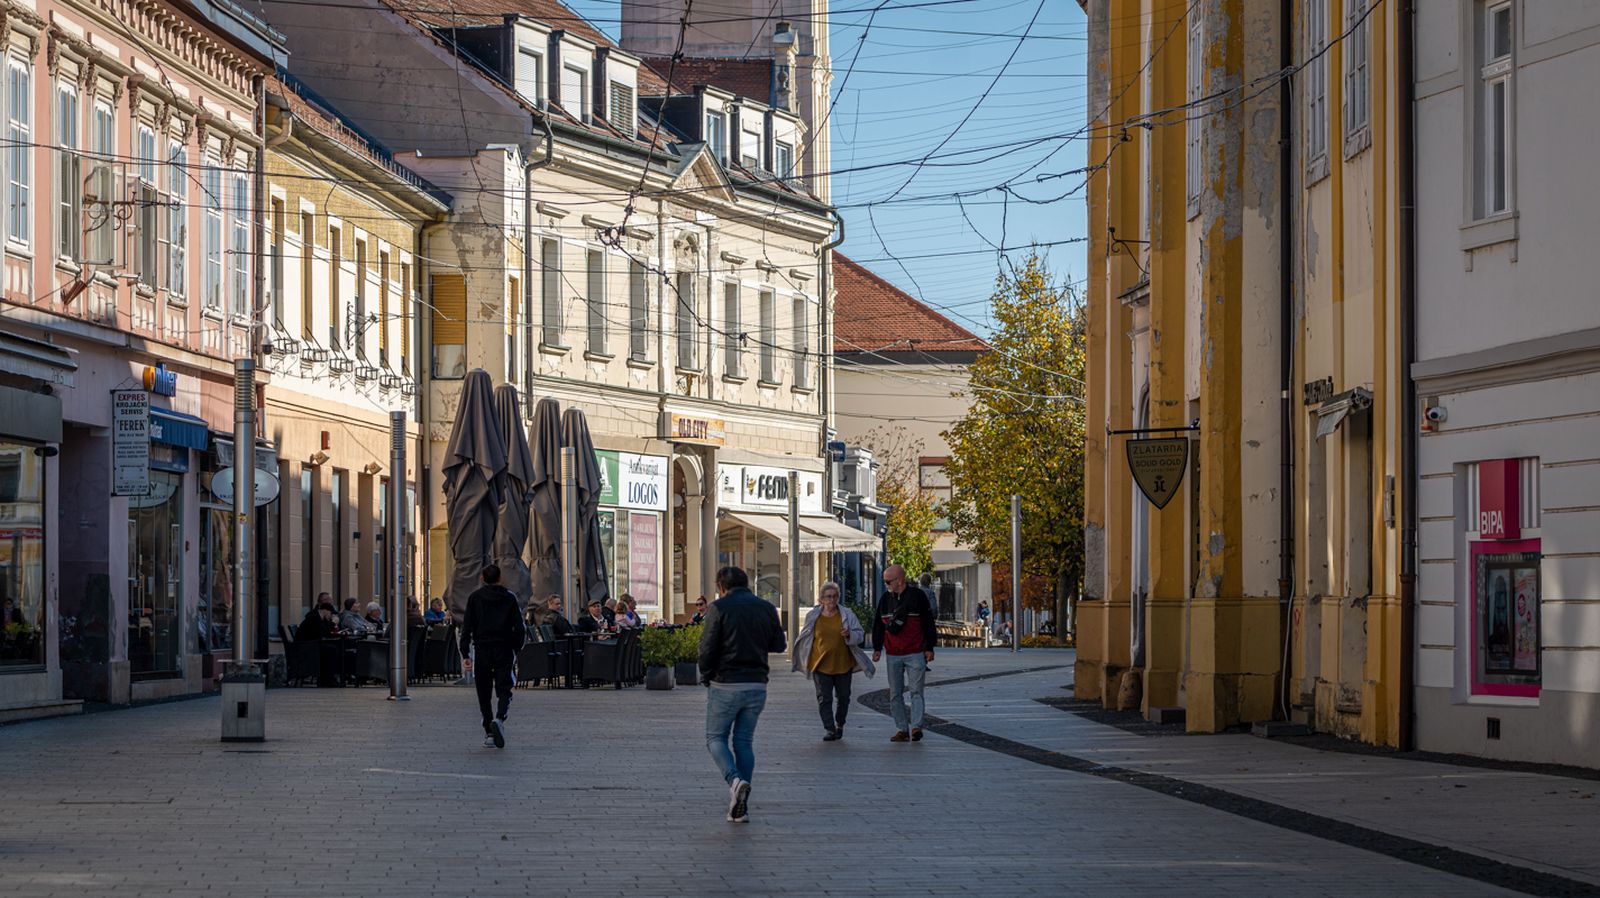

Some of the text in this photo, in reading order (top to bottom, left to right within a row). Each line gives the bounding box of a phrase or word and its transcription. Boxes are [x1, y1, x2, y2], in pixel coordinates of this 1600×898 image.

[118, 393, 146, 401] EXPRES
[678, 417, 692, 438] OLD
[1133, 445, 1182, 454] ZLATARNA
[628, 481, 659, 506] LOGOS
[1481, 511, 1504, 535] BIPA
